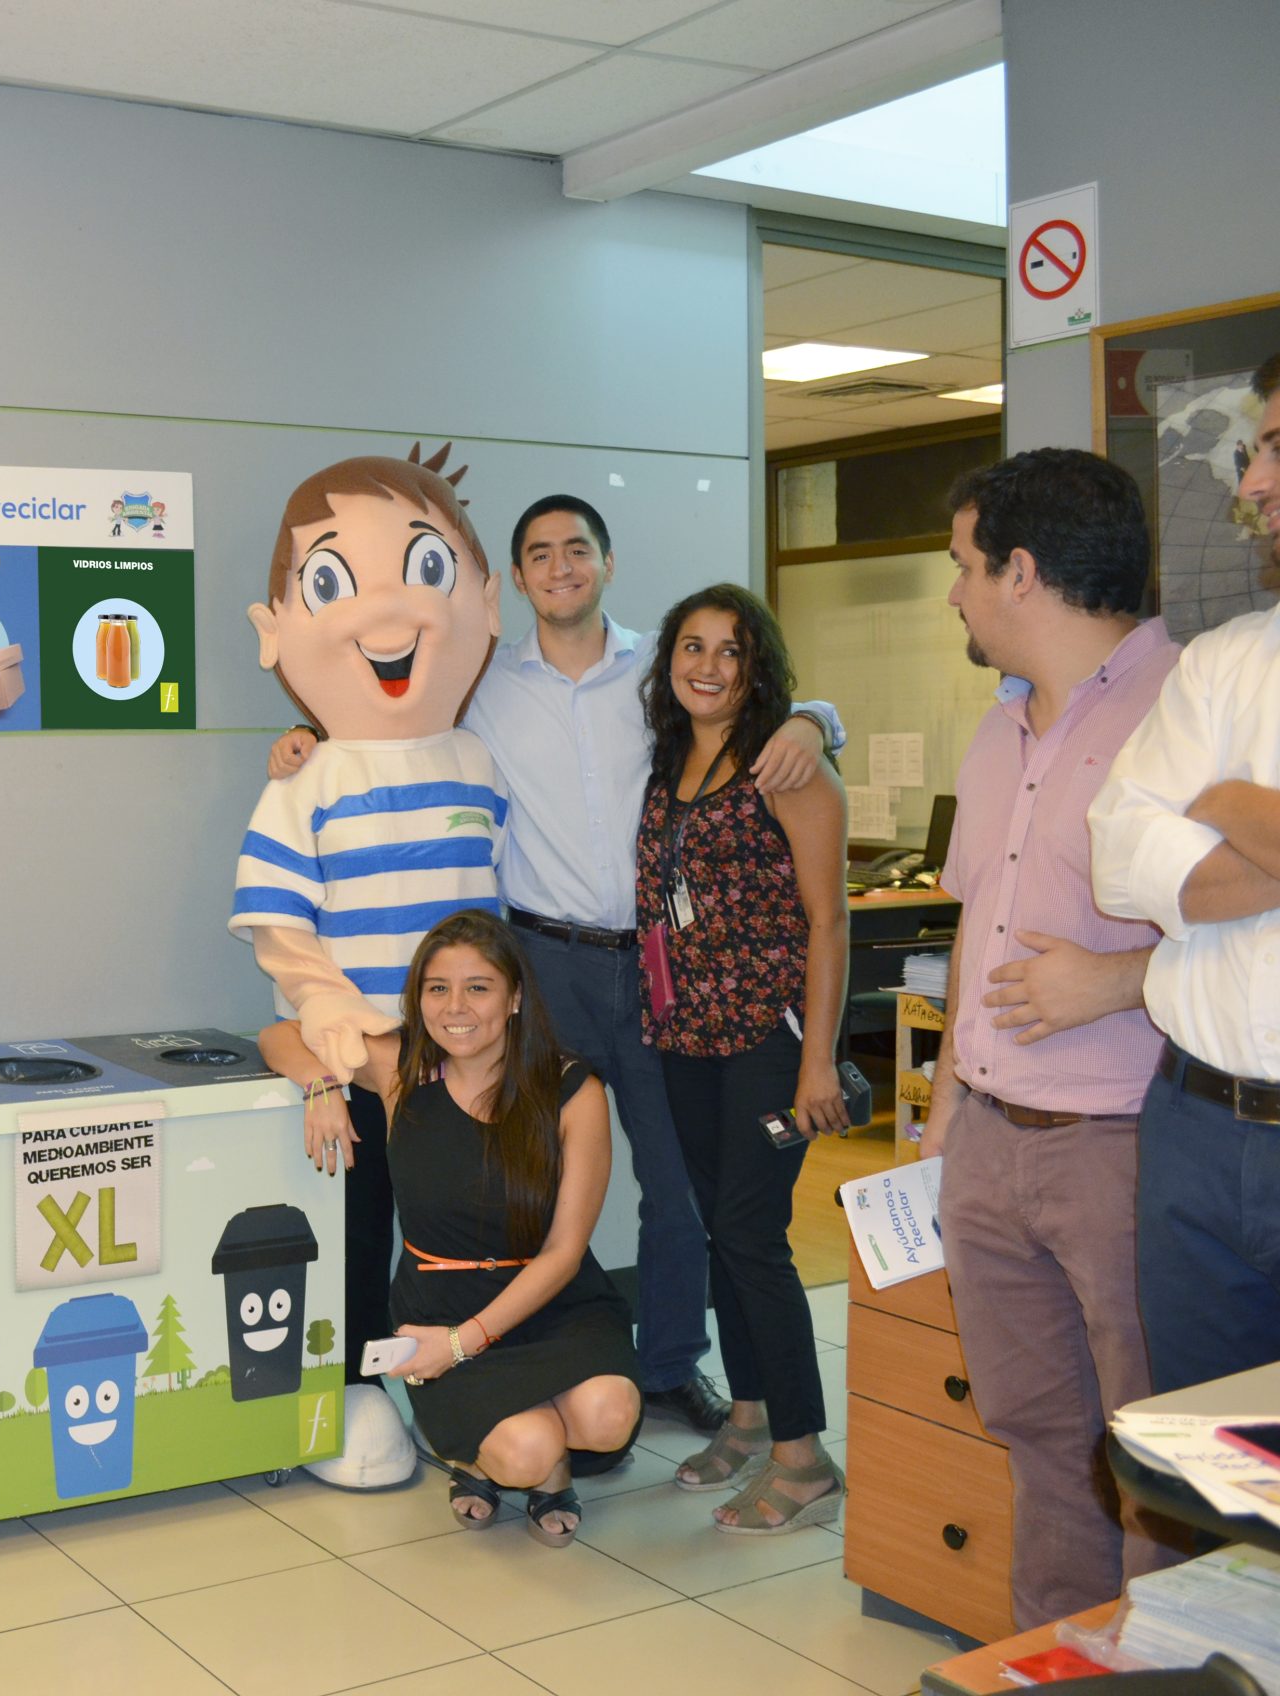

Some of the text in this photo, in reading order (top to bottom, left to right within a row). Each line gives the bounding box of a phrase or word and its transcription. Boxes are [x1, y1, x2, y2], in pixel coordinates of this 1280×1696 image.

[73, 560, 154, 571] VIDRIOS LIMPIOS
[22, 1129, 66, 1144] PARA
[23, 1134, 154, 1164] MEDIOAMBIENTE
[27, 1155, 152, 1184] QUEREMOS SER
[36, 1187, 138, 1273] XL
[883, 1178, 920, 1264] Ayúdanos a
[898, 1189, 926, 1248] Reciclar
